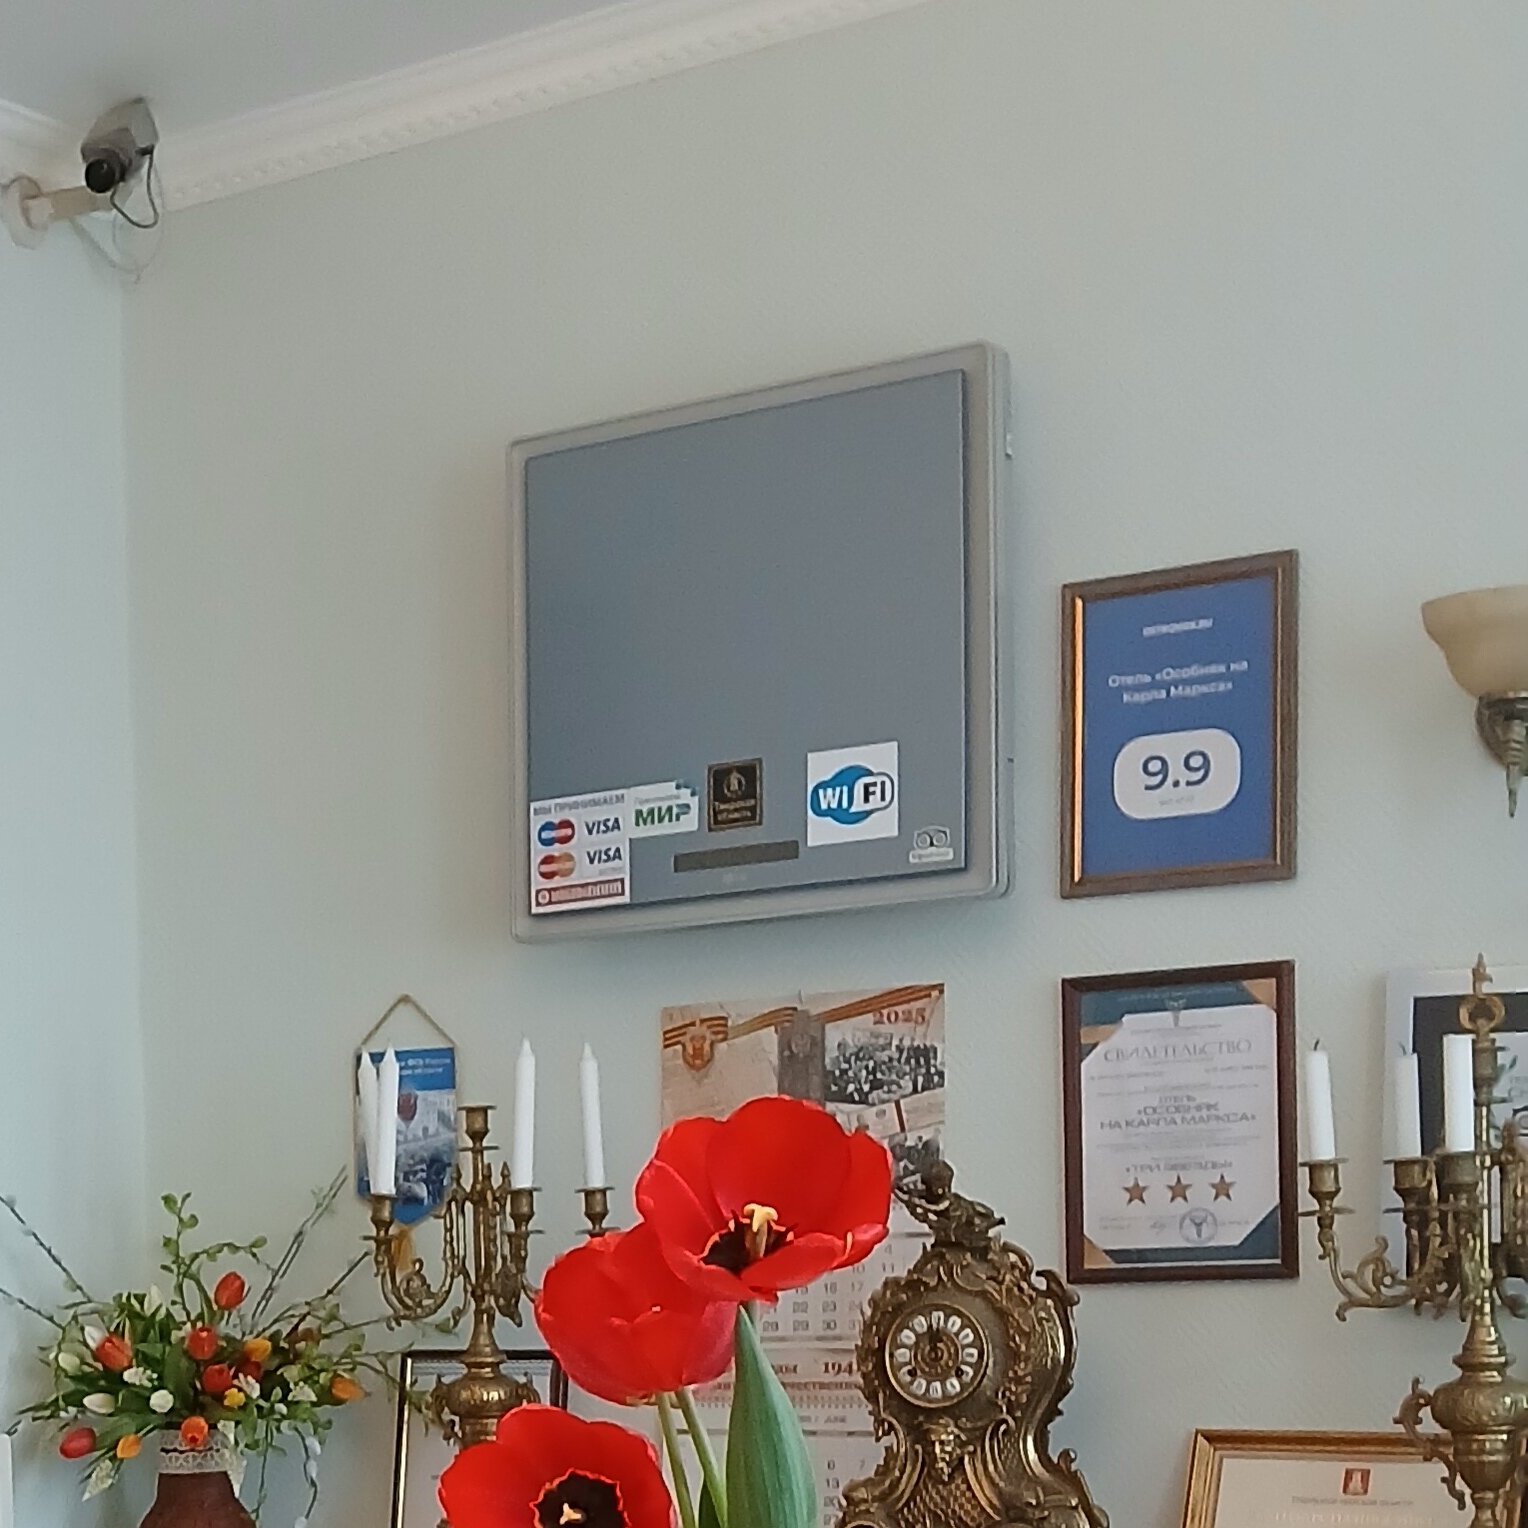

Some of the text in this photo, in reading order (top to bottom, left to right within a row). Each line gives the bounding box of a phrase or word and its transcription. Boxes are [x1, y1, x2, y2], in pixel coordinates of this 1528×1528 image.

[1141, 750, 1211, 791] 9.9
[634, 803, 691, 828] МИР
[584, 817, 621, 836] VISA
[586, 847, 622, 865] VISA
[873, 1008, 926, 1025] 2025
[1104, 1039, 1252, 1062] СВИДЕТЕЛЬСТВО
